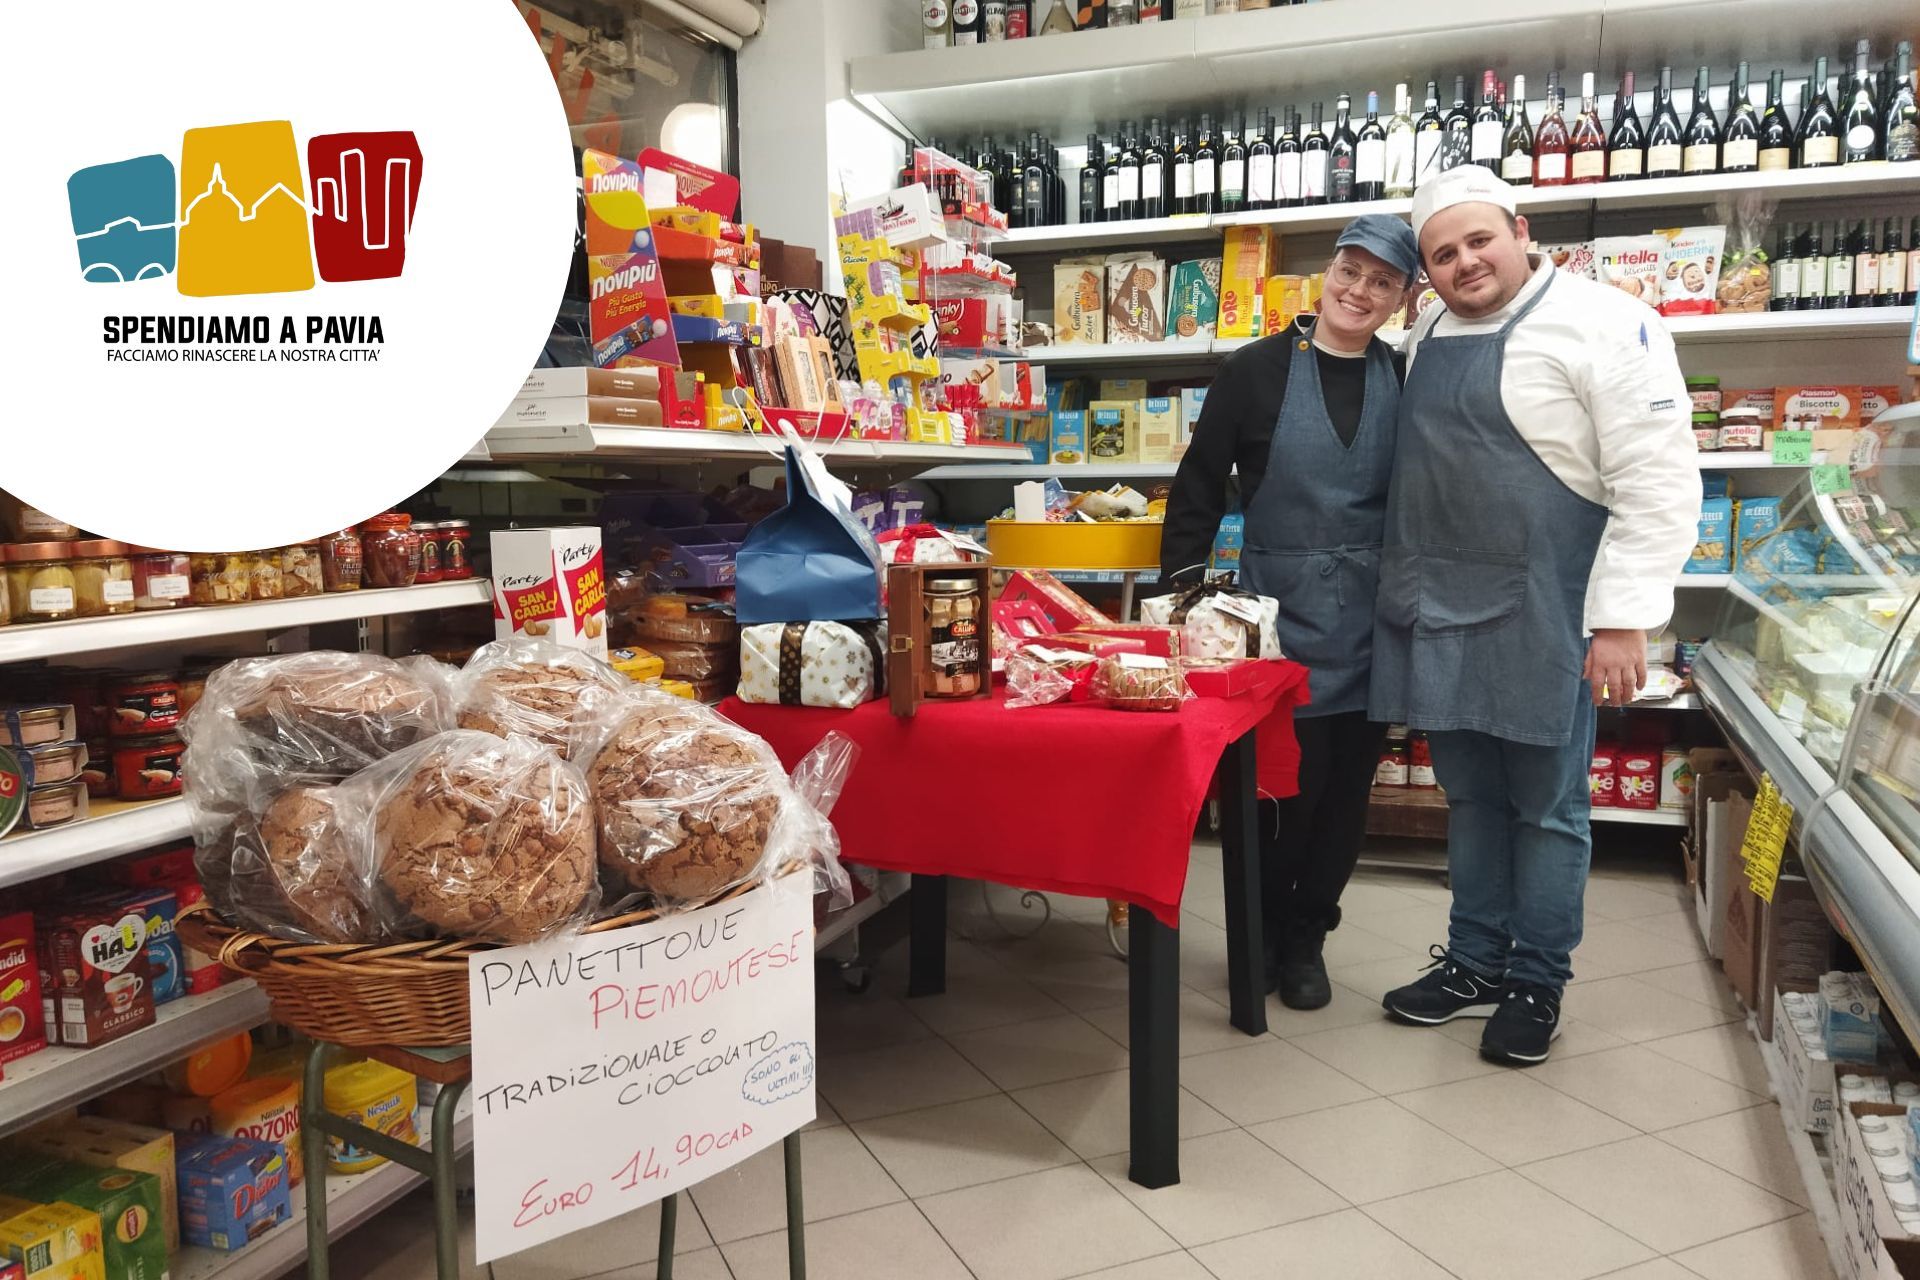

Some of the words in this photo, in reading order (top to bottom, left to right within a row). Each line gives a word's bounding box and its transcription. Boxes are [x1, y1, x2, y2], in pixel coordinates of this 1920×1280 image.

[1222, 290, 1238, 326] ORO
[1799, 400, 1840, 409] Biscotto
[1723, 426, 1757, 436] nutella
[562, 543, 595, 566] Party
[502, 574, 543, 589] Party
[577, 567, 599, 595] SAN
[514, 593, 557, 620] CARLO
[518, 591, 546, 607] SAN
[574, 581, 606, 617] CARLO
[480, 908, 745, 1006] PANETTONE
[103, 1006, 145, 1029] CLASSICO
[750, 1060, 781, 1084] SONO
[366, 1095, 401, 1118] Nesquik
[231, 1172, 283, 1220] Dietor
